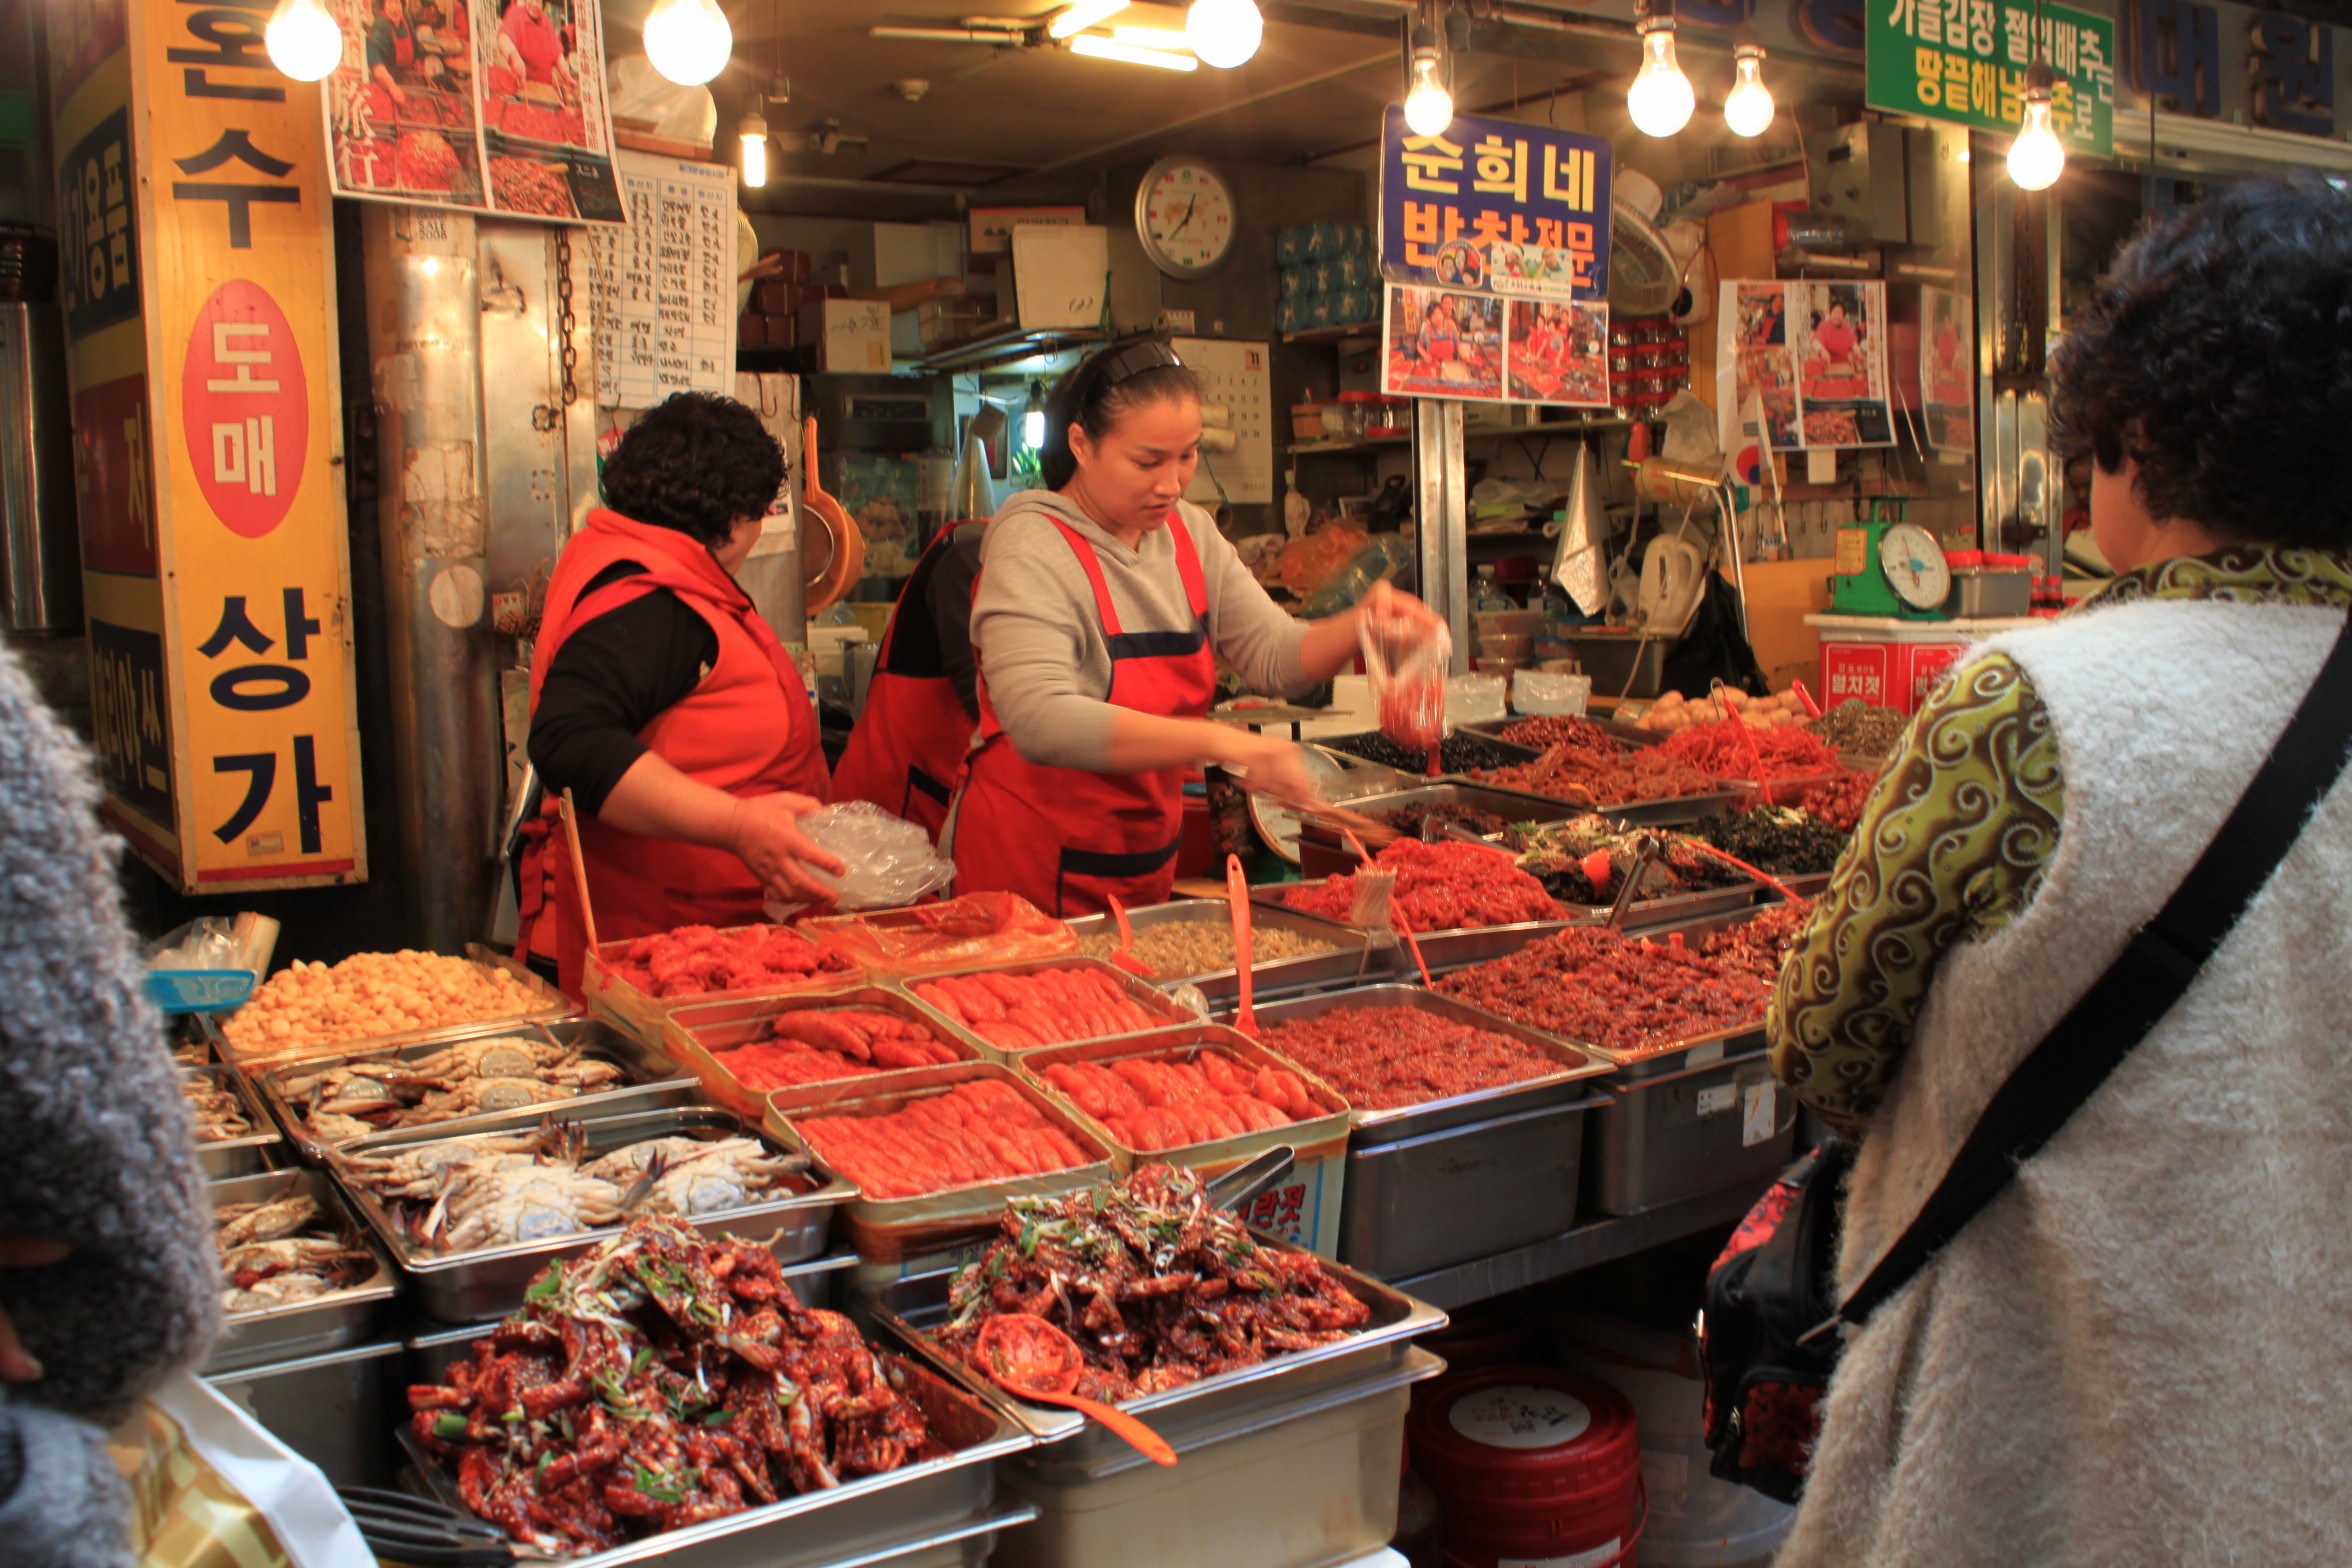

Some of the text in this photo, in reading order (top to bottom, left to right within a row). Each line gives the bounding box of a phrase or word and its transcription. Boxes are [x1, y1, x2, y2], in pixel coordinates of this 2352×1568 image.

[1888, 0, 1996, 56] 가을김장
[1401, 134, 1595, 213] 순희네
[206, 321, 280, 496] 도매
[1832, 674, 1880, 695] 멸치젓
[197, 587, 332, 854] 상가
[1240, 1183, 1306, 1229] 란젓
